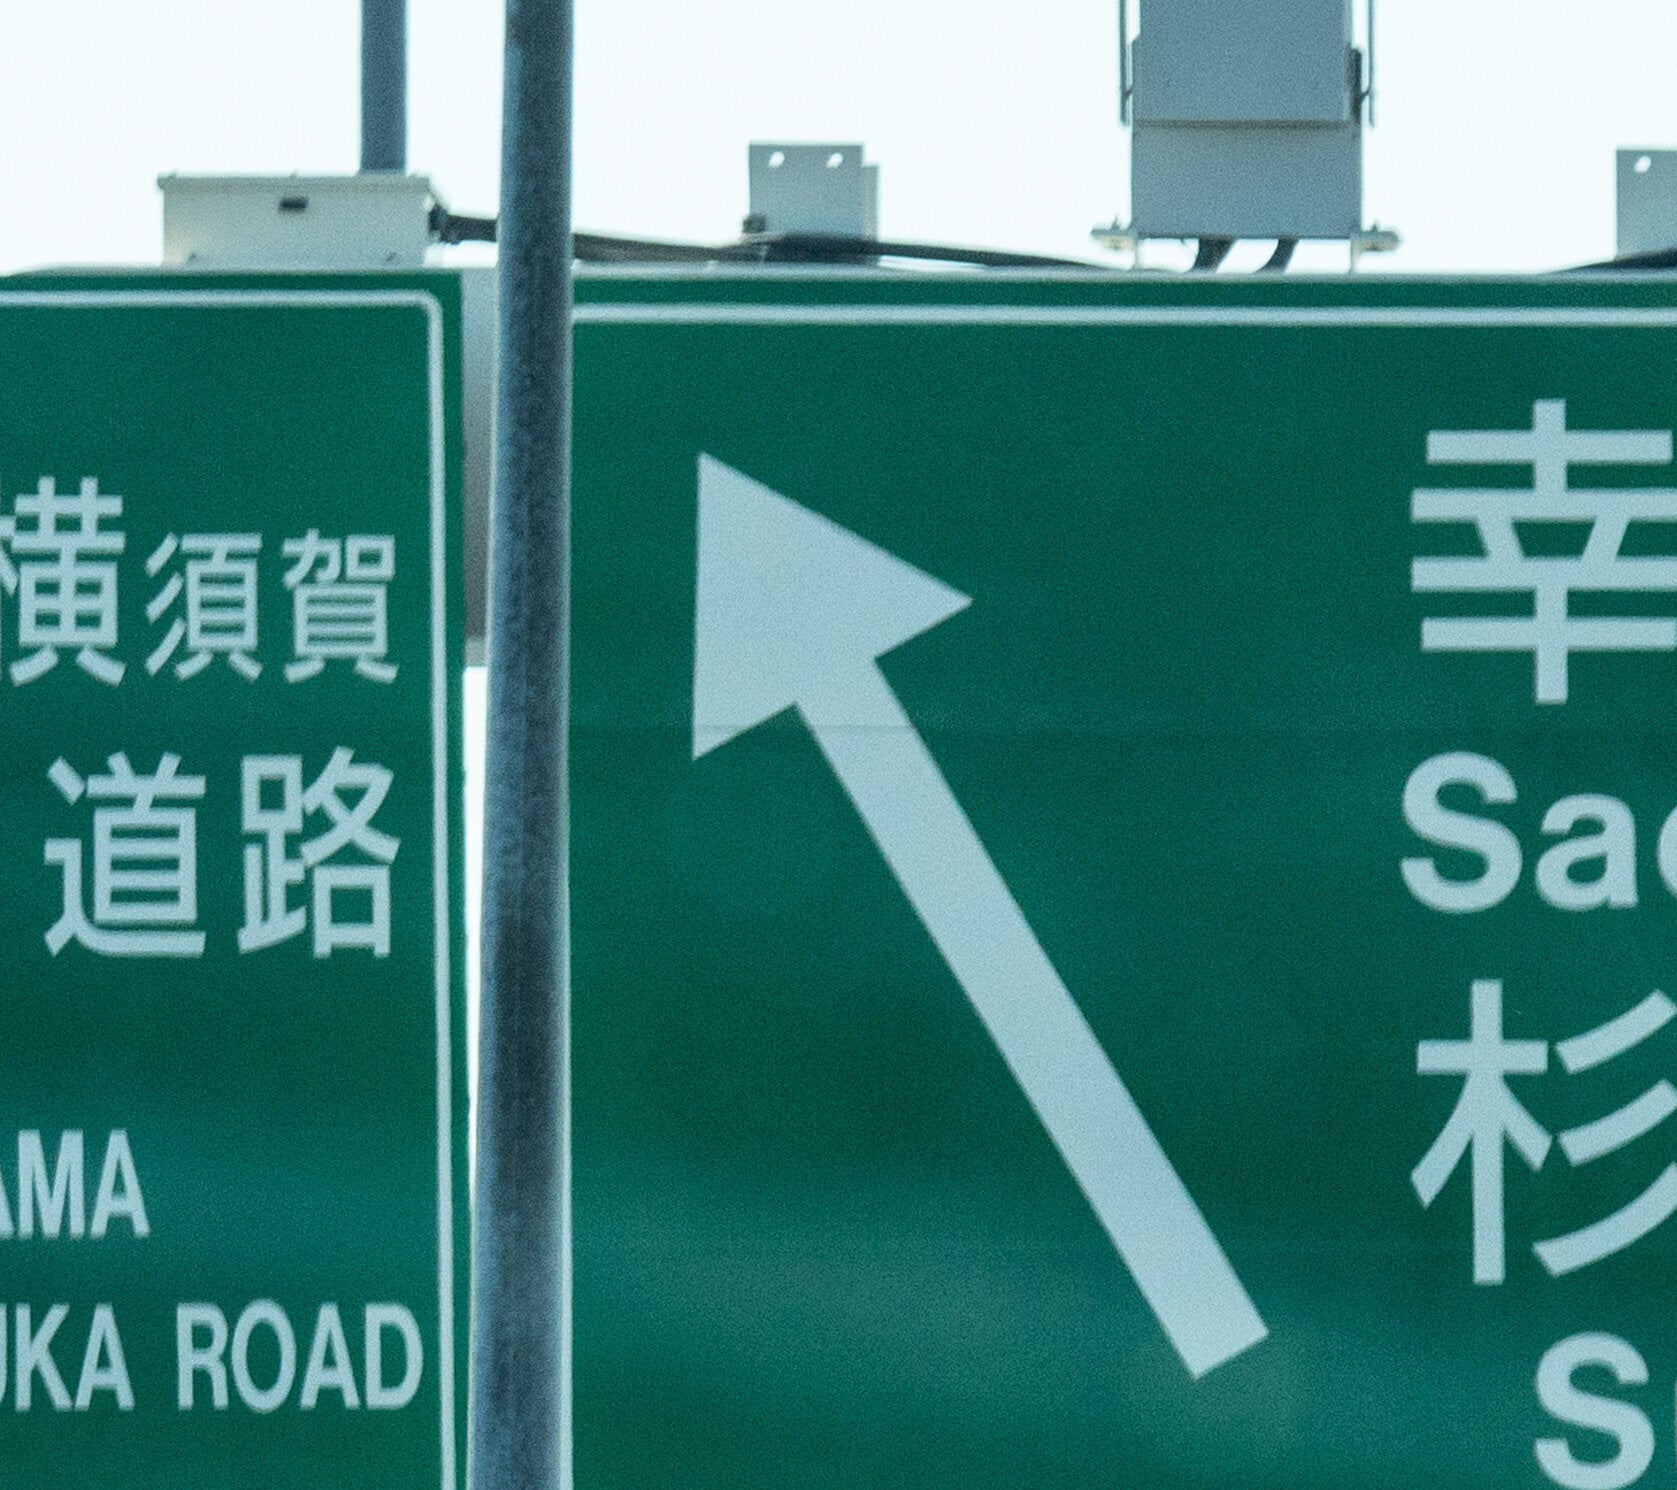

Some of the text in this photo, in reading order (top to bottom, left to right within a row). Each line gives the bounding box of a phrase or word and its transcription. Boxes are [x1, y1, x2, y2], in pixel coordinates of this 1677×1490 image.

[0, 477, 397, 685] 横須賀
[44, 747, 400, 957] 道路
[176, 1300, 423, 1412] ROAD
